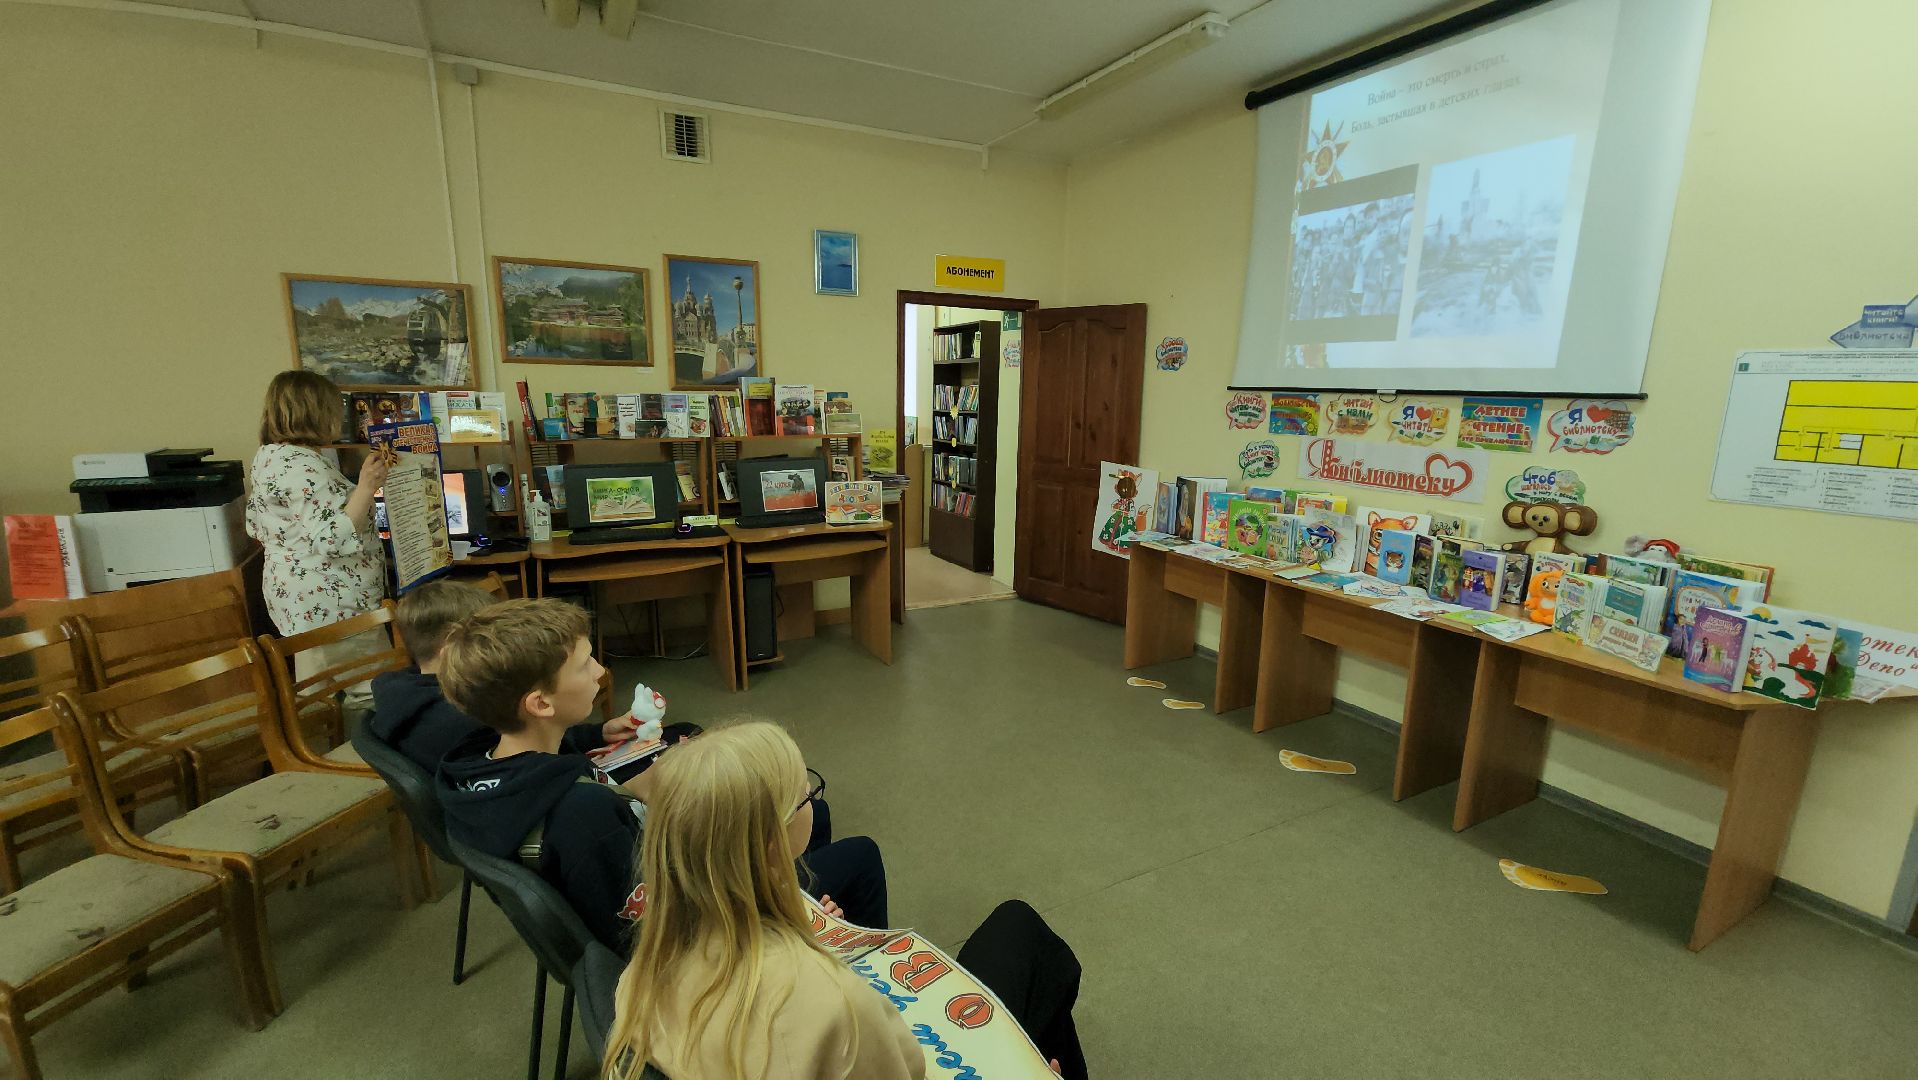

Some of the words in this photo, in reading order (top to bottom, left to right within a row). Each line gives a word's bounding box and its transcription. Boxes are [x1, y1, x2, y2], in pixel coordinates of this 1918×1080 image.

[1367, 88, 1396, 106] Война
[1407, 81, 1423, 93] это
[1425, 70, 1462, 89] смерть
[1438, 87, 1480, 109] детских
[945, 265, 995, 280] АБОНЕМЕНТ
[1402, 405, 1415, 420] Я
[1474, 405, 1527, 418] ЛЕТНЕЕ
[1568, 407, 1583, 425] Я
[398, 423, 436, 437] ВЕЛИКАЯ
[411, 443, 439, 455] ВОЙНА
[944, 992, 995, 1030] О
